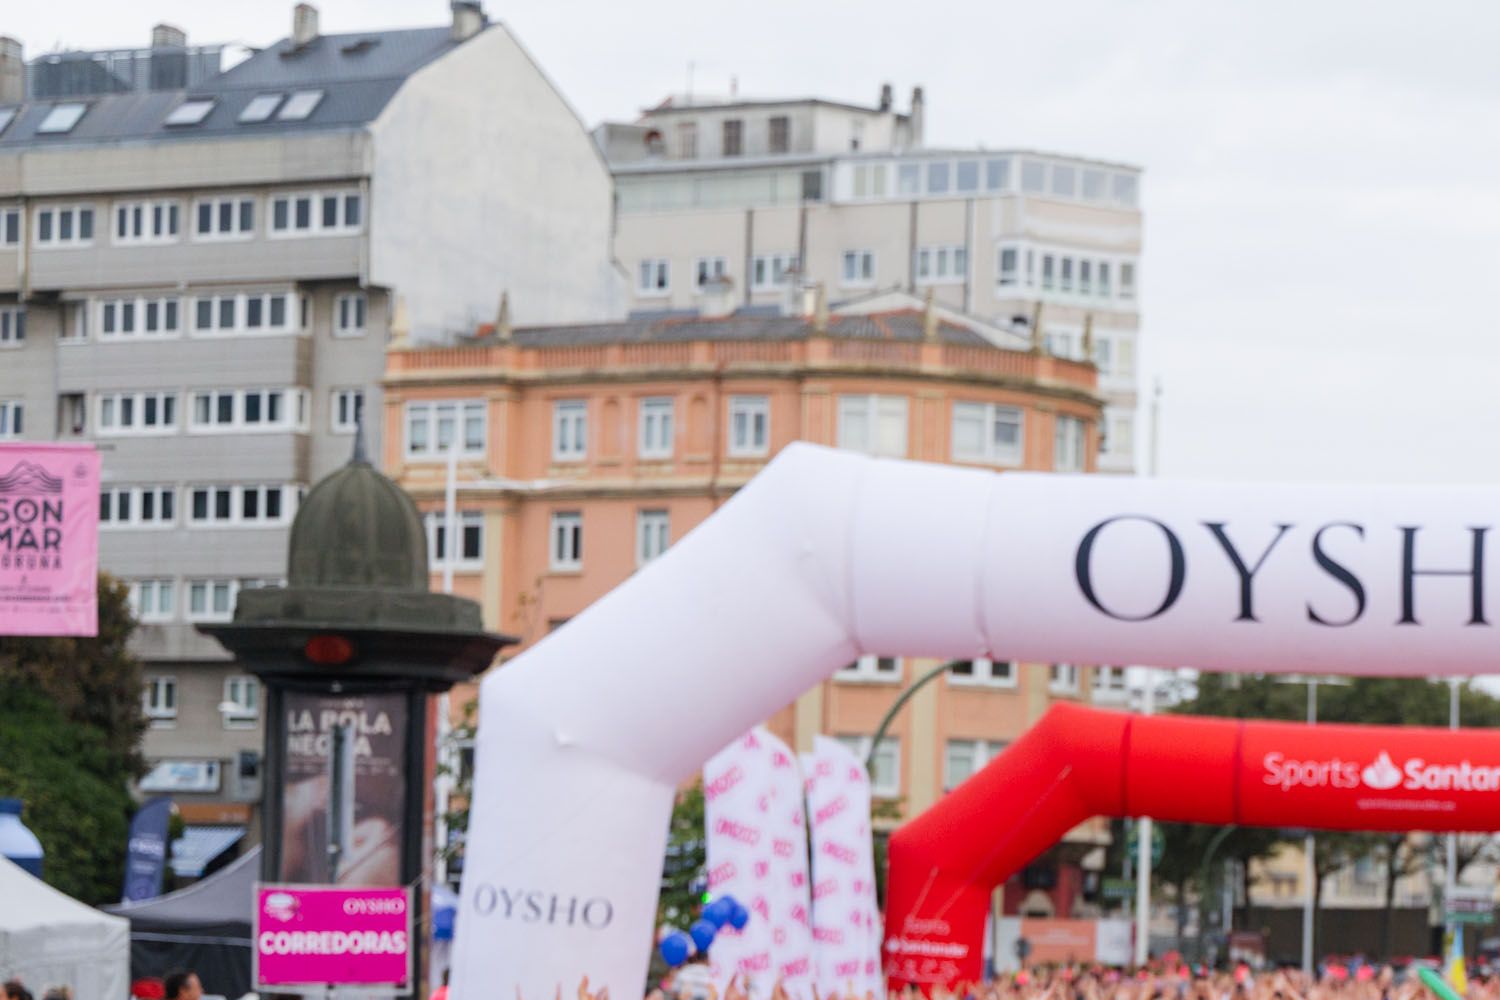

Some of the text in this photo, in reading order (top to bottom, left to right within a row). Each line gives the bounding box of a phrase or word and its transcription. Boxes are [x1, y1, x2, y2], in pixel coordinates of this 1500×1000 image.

[287, 709, 315, 732] LA
[287, 733, 373, 757] NEGA
[1262, 751, 1360, 791] Sports
[343, 897, 406, 916] OYSHO
[473, 882, 614, 931] OYSHO
[259, 930, 408, 956] CORREDORAS
